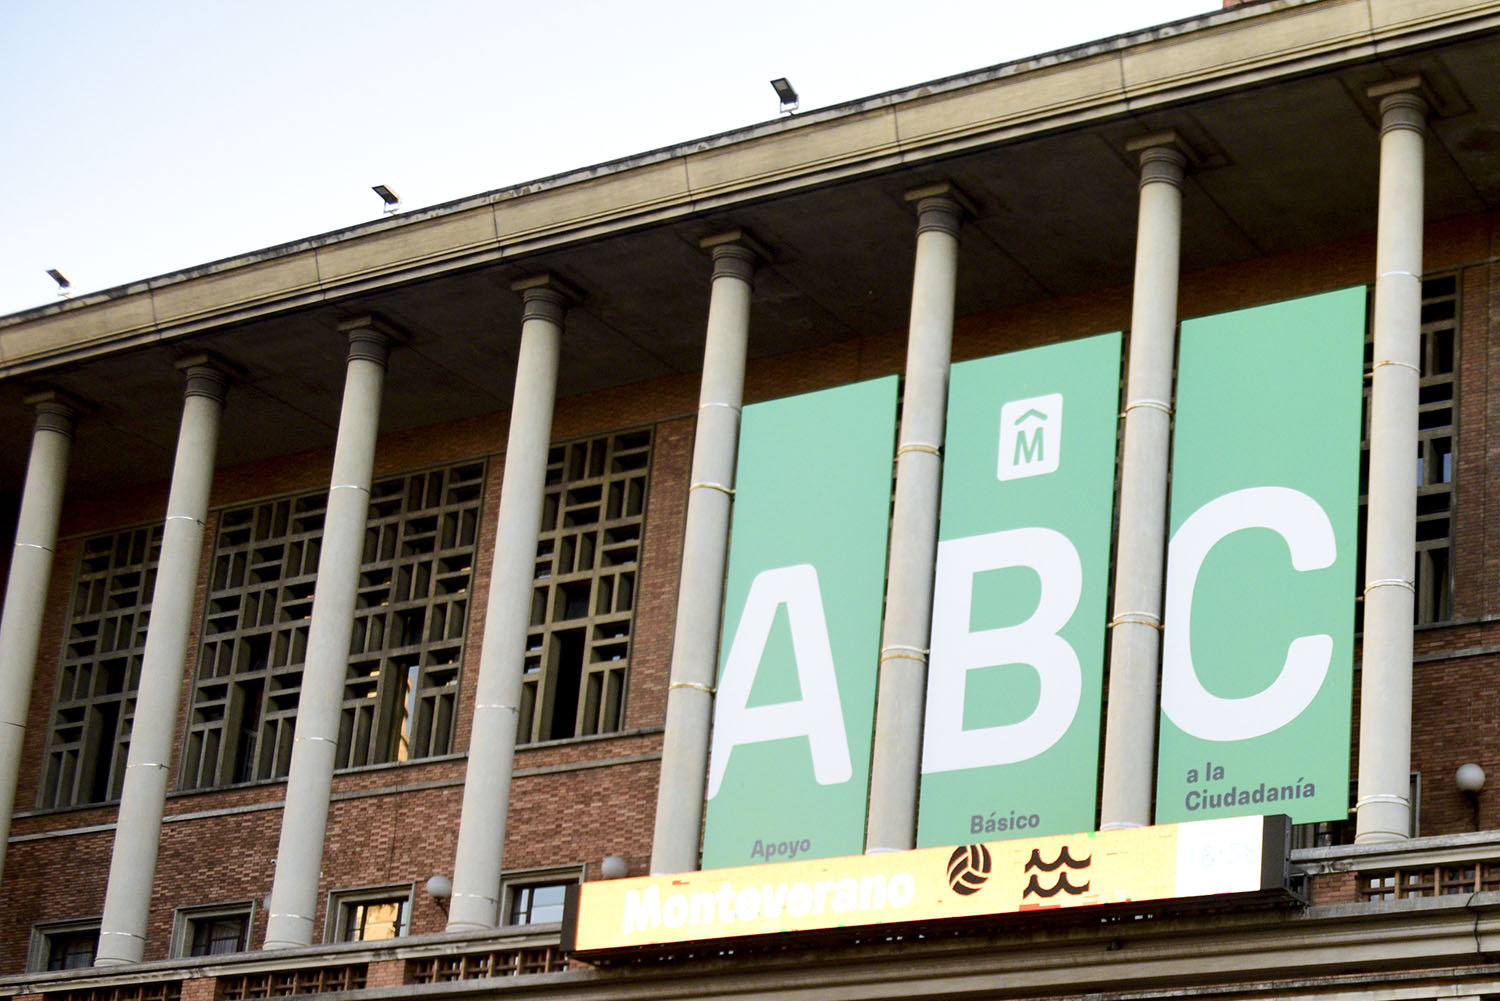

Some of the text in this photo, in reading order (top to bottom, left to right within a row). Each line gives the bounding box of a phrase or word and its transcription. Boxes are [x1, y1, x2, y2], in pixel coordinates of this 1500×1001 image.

[707, 486, 1337, 801] A B C
[1186, 762, 1225, 785] a la
[1185, 778, 1317, 812] Ciudadanía
[970, 811, 1041, 835] Básico
[750, 836, 811, 860] Apoyo
[622, 870, 915, 935] Monteverano
